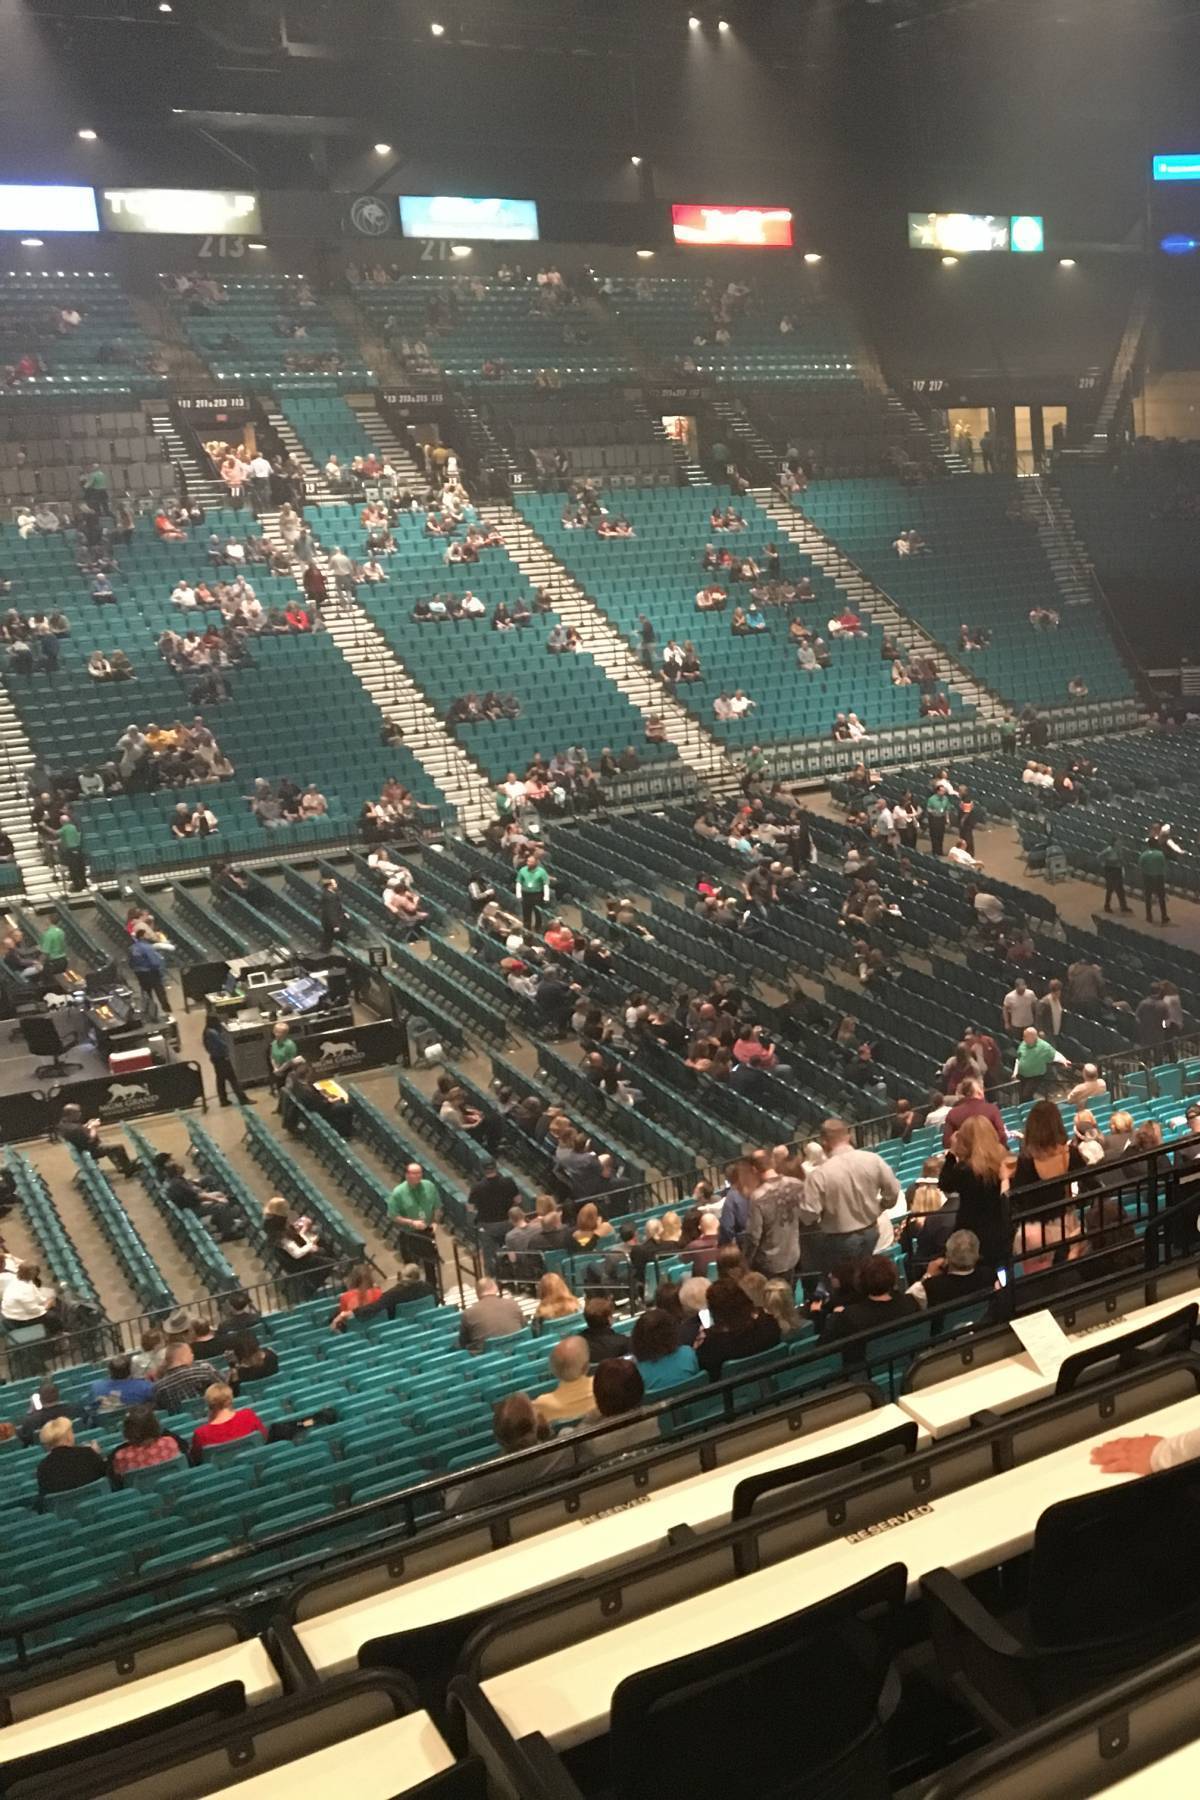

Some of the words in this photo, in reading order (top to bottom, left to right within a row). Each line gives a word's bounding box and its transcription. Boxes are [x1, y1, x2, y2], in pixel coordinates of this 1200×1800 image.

[198, 235, 246, 258] 213
[420, 240, 456, 261] 21
[846, 1504, 933, 1543] RESERVED
